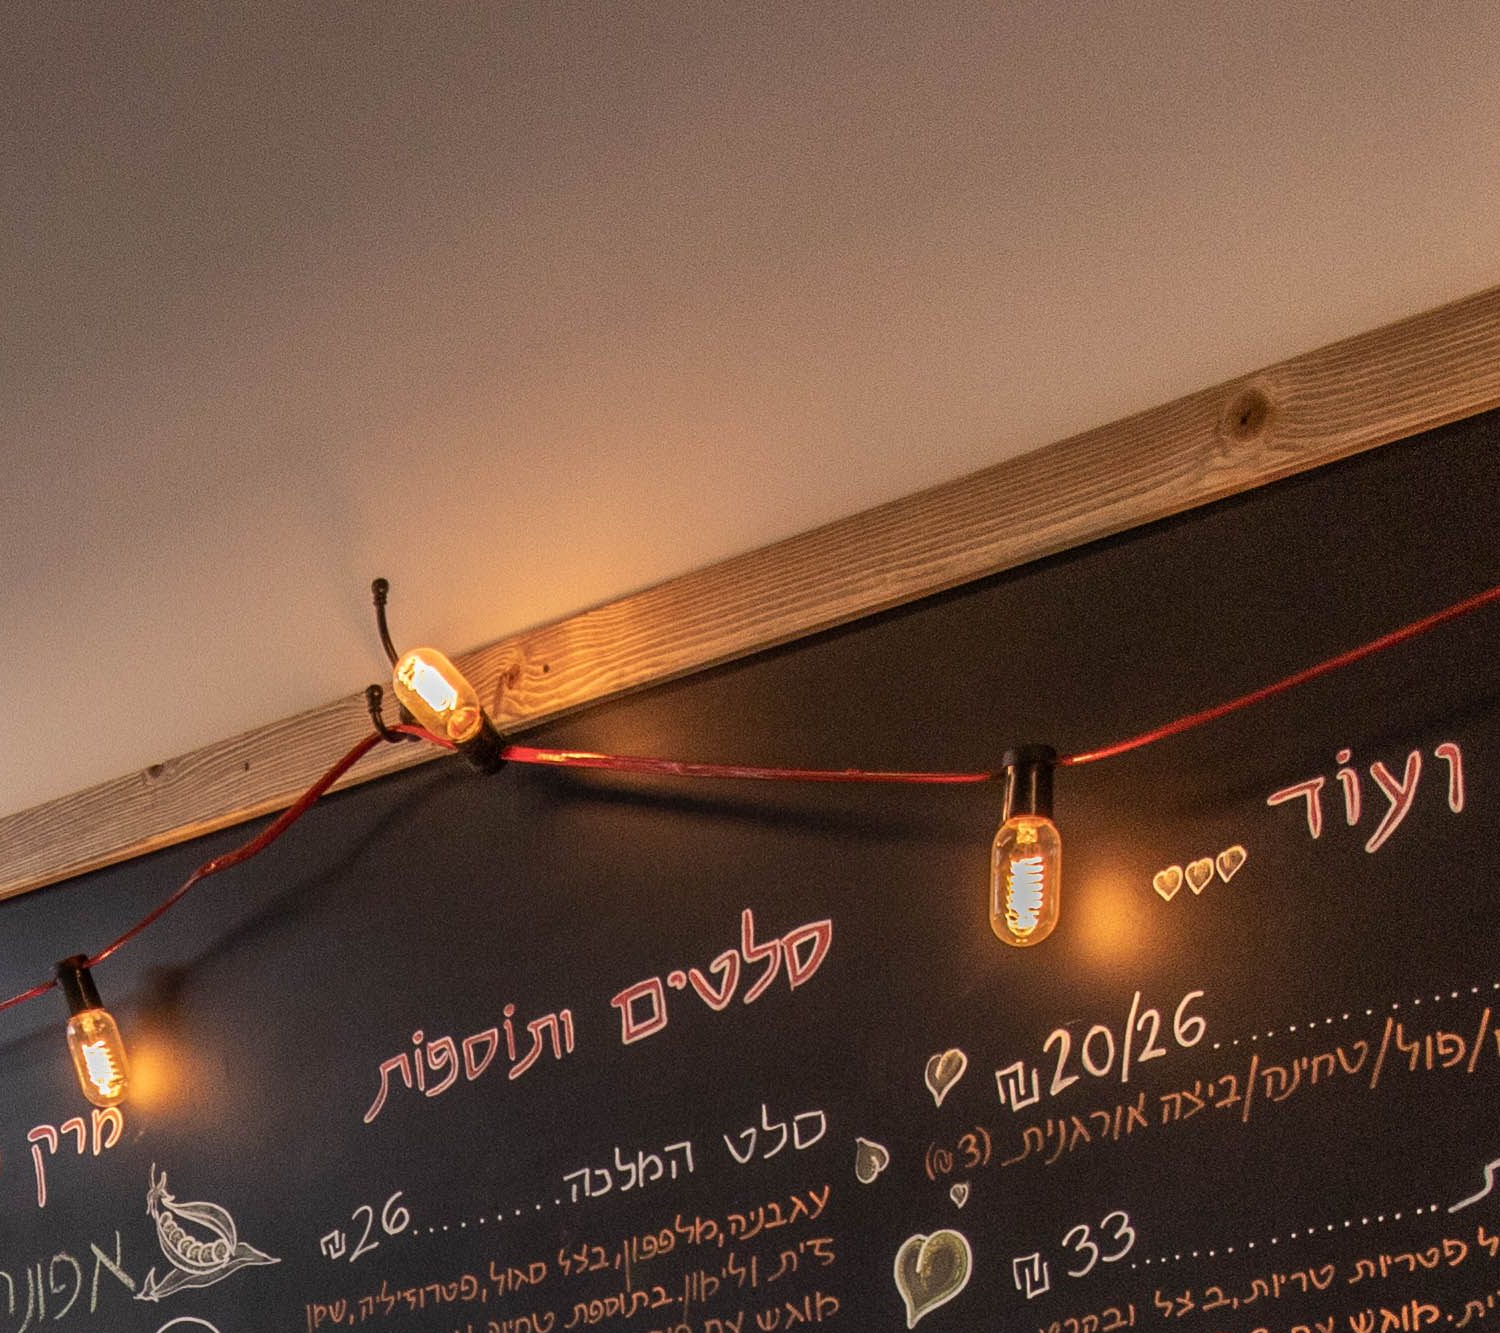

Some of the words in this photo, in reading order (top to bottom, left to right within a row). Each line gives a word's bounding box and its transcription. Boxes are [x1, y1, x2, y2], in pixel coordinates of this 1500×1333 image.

[1266, 742, 1465, 853] ועוד
[610, 908, 833, 1045] סלטים
[363, 1004, 575, 1124] ותוספות
[27, 1107, 124, 1207] מרק
[723, 1103, 828, 1164] סלט
[1000, 1094, 1150, 1167] אורגנית
[563, 1140, 695, 1203] המלכה
[768, 1237, 835, 1282] זית
[1348, 1238, 1469, 1284] פטריות
[755, 1291, 840, 1332] מוגש
